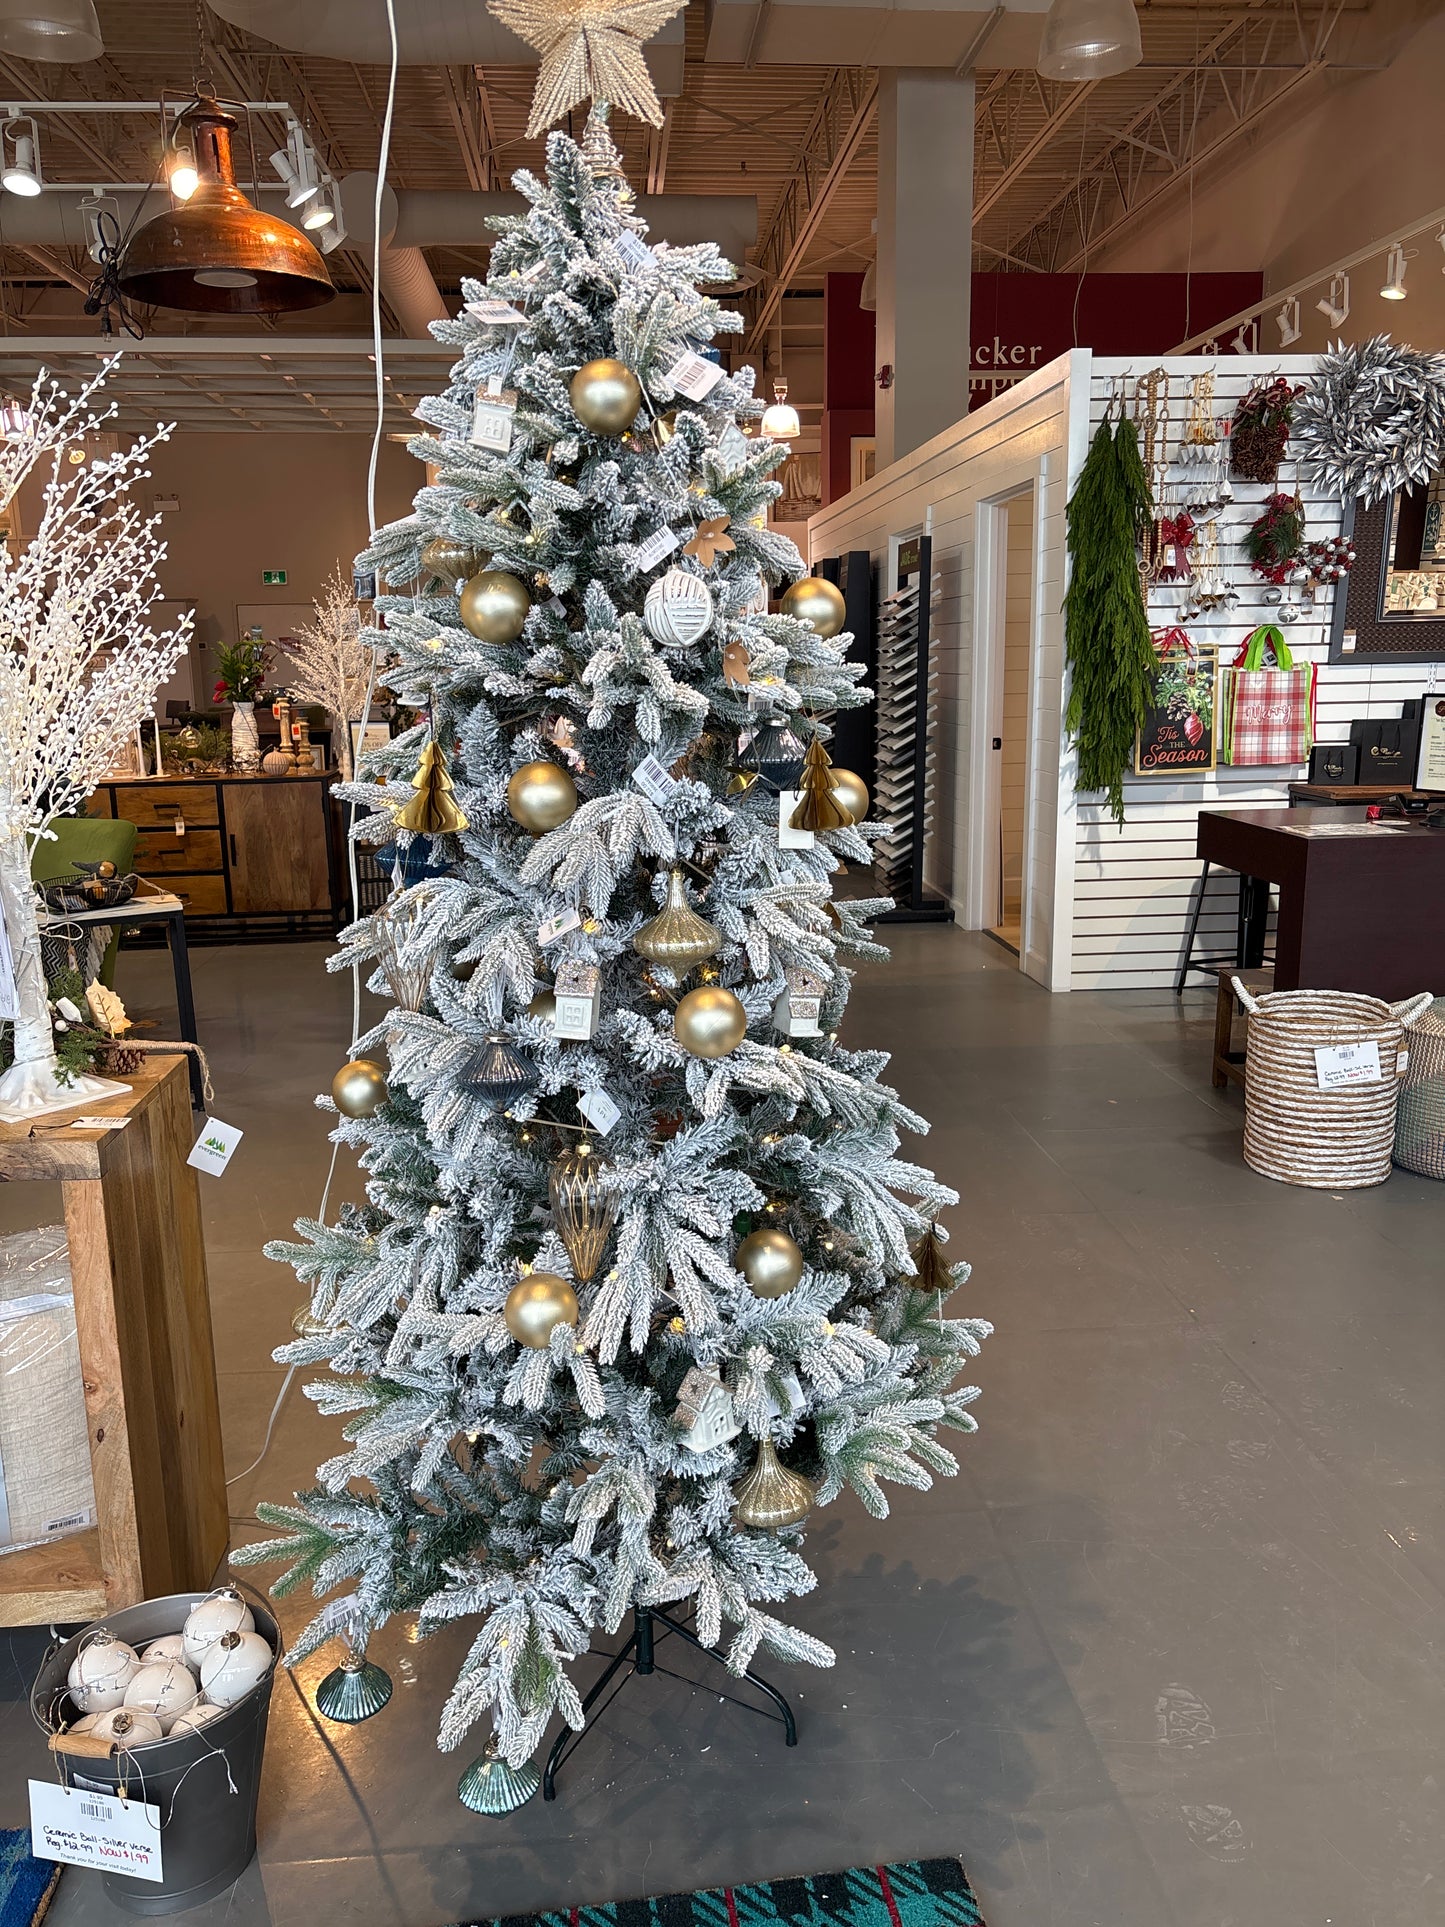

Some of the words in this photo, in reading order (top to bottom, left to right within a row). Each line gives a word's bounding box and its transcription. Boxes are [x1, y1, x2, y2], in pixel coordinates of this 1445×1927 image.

[969, 336, 1042, 364] cker
[1246, 703, 1292, 726] Merry
[1143, 744, 1208, 768] Season
[197, 1145, 227, 1160] evergreen
[43, 1825, 77, 1840] Ceramic
[123, 1850, 149, 1864] $1.99
[119, 1863, 137, 1873] today!
